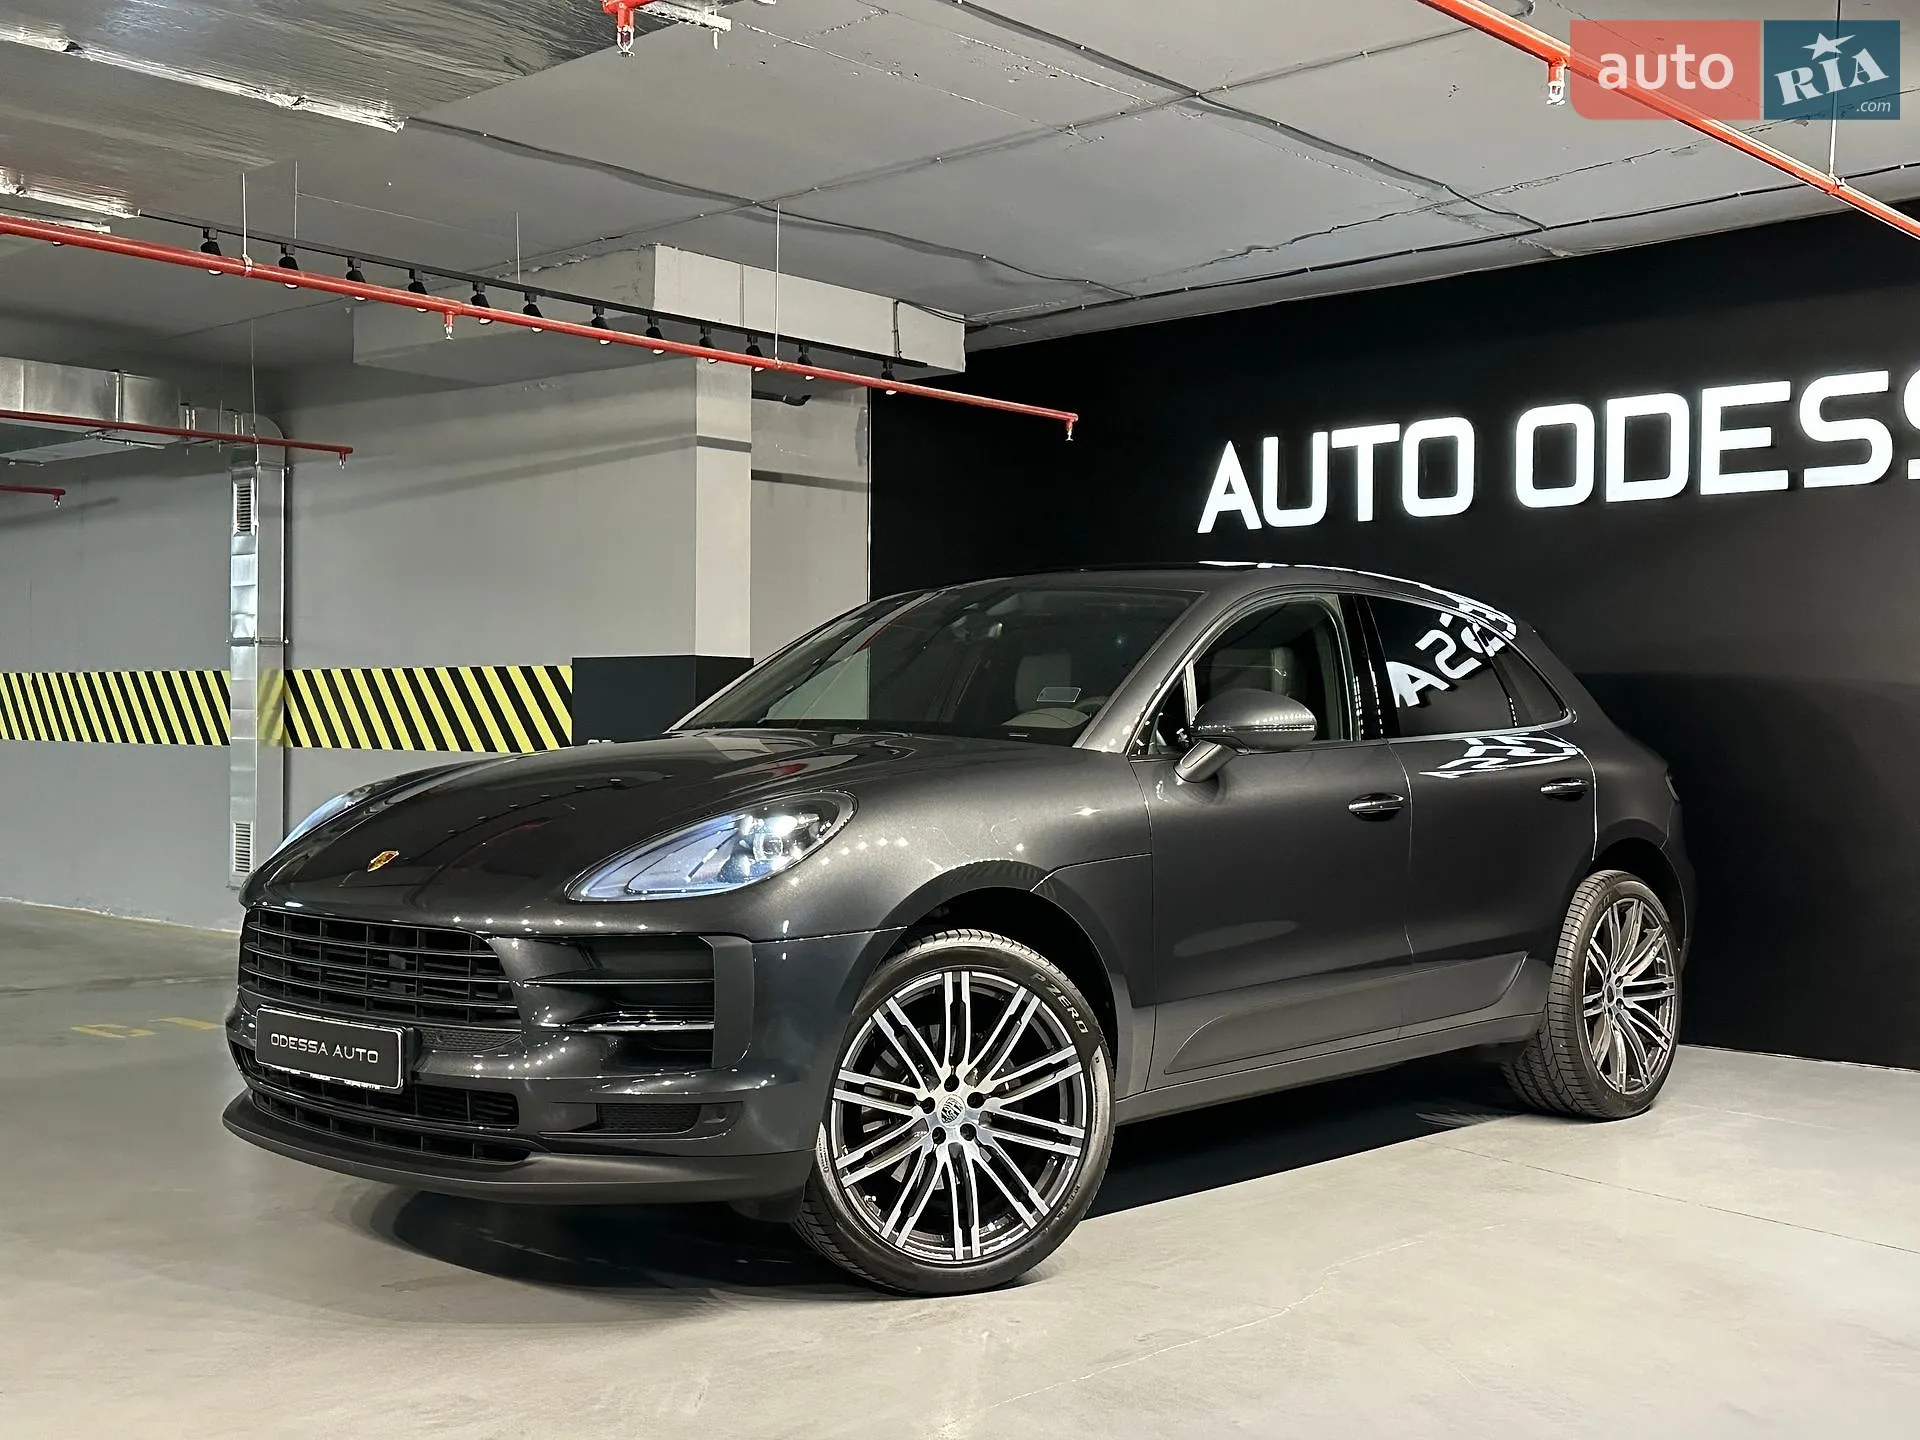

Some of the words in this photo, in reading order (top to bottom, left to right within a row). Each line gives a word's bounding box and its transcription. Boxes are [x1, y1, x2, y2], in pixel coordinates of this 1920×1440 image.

[1197, 417, 1475, 534] AUTO
[1515, 368, 1920, 509] ODES
[270, 1033, 328, 1056] ODESSA
[332, 1044, 379, 1064] AUTO
